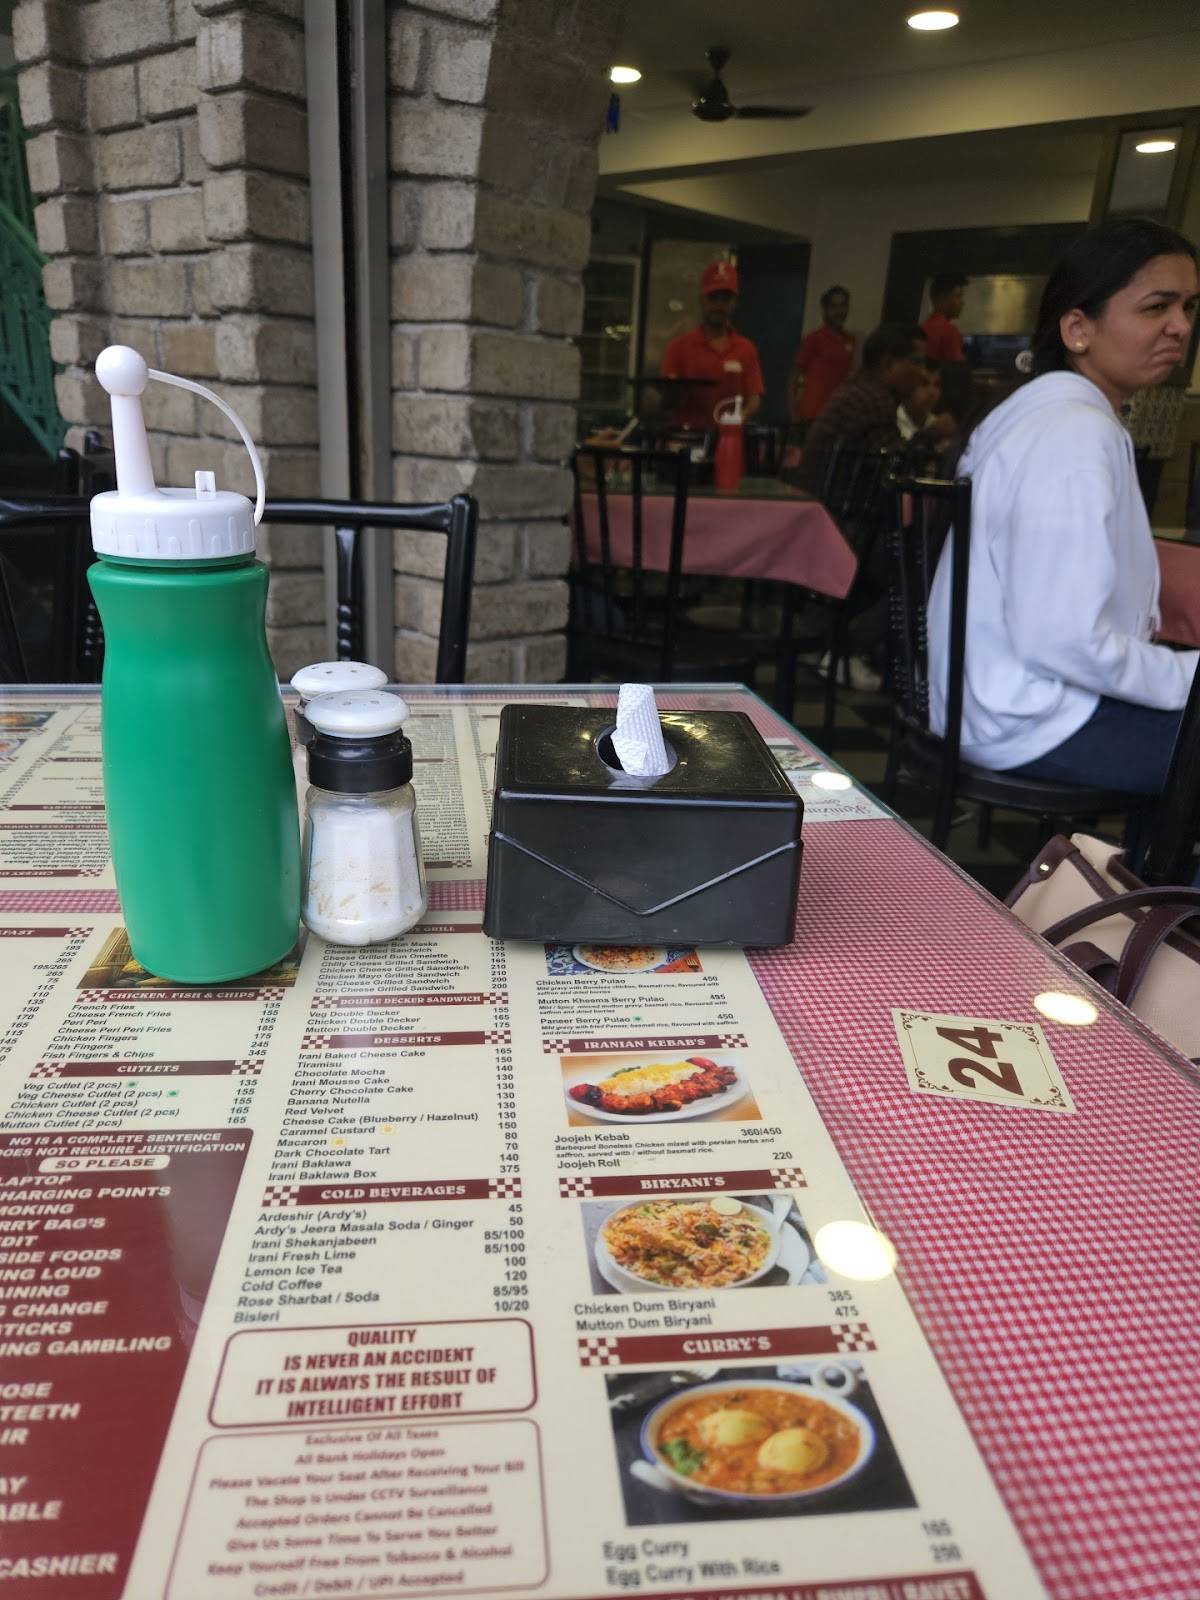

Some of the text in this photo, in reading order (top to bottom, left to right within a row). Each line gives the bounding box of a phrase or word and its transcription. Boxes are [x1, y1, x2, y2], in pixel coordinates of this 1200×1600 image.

[98, 1034, 138, 1042] Fingers
[374, 1035, 441, 1044] DESSERTS
[584, 1038, 706, 1049] IRANIAN KEBAB'S
[68, 1051, 109, 1059] Fingers
[124, 1050, 154, 1058] Chips
[936, 1026, 1024, 1096] 24
[117, 1065, 180, 1073] CUTLETS
[23, 1082, 44, 1091] Veg
[47, 1081, 81, 1089] Cutlet
[97, 1080, 122, 1089] pcs)
[5, 1110, 52, 1119] Chicken
[58, 1109, 101, 1118] Cheese
[104, 1109, 138, 1117] Cutlet
[141, 1108, 153, 1117] (2
[155, 1108, 180, 1117] pcs)
[67, 1134, 143, 1143] COMPLETE
[147, 1133, 221, 1141] SENTENCE
[277, 1138, 327, 1146] Macaron
[554, 1127, 782, 1144] Joojeh Kebab 360/450
[36, 1147, 66, 1156] NOT
[71, 1146, 134, 1155] REQUIRE
[138, 1143, 245, 1153] JUSTIFICATION
[274, 1149, 302, 1158] Dark
[305, 1147, 365, 1157] Chocolate
[369, 1147, 390, 1155] Tart
[55, 1158, 156, 1169] SO PLEASE
[558, 1152, 792, 1170] Joojeh Roll 220
[268, 1172, 296, 1181] Irani
[299, 1171, 350, 1180] Baklawa
[353, 1170, 377, 1178] Box
[640, 1176, 726, 1189] BIRYANI'S
[98, 1187, 171, 1198] POINTS
[321, 1185, 466, 1199] COLD BEVERAGES
[257, 1211, 314, 1222] Ardeshir
[317, 1209, 367, 1222] (Ardy's)
[44, 1218, 106, 1230] BAG'S
[251, 1230, 524, 1249] Irani Shekanjabeen 85/100
[49, 1249, 122, 1262] FOODS
[41, 1267, 101, 1280] LOUD
[241, 1271, 527, 1292] Cold Coffee 120
[12, 1302, 108, 1317] CHANGE
[233, 1300, 529, 1323] Bisleri 10/20
[574, 1302, 629, 1315] Chicken
[633, 1301, 664, 1312] Dum
[668, 1298, 716, 1312] Biryani
[576, 1306, 859, 1330] Mutton Dum Biryani 475
[348, 1329, 417, 1346] QUALITY
[48, 1337, 171, 1355] GAMBLING
[683, 1337, 771, 1353] CURRY'S
[284, 1347, 474, 1371] IS NEVER AN ACCIDENT
[256, 1368, 496, 1395] IT IS ALWAYS THE RESULT OF
[287, 1393, 462, 1418] INTELLIGENT EFFORT
[603, 1542, 637, 1561] Egg
[642, 1539, 689, 1557] Curry
[606, 1567, 641, 1586] Egg
[647, 1564, 693, 1583] Curry
[699, 1560, 738, 1577] With
[743, 1558, 780, 1574] Rice
